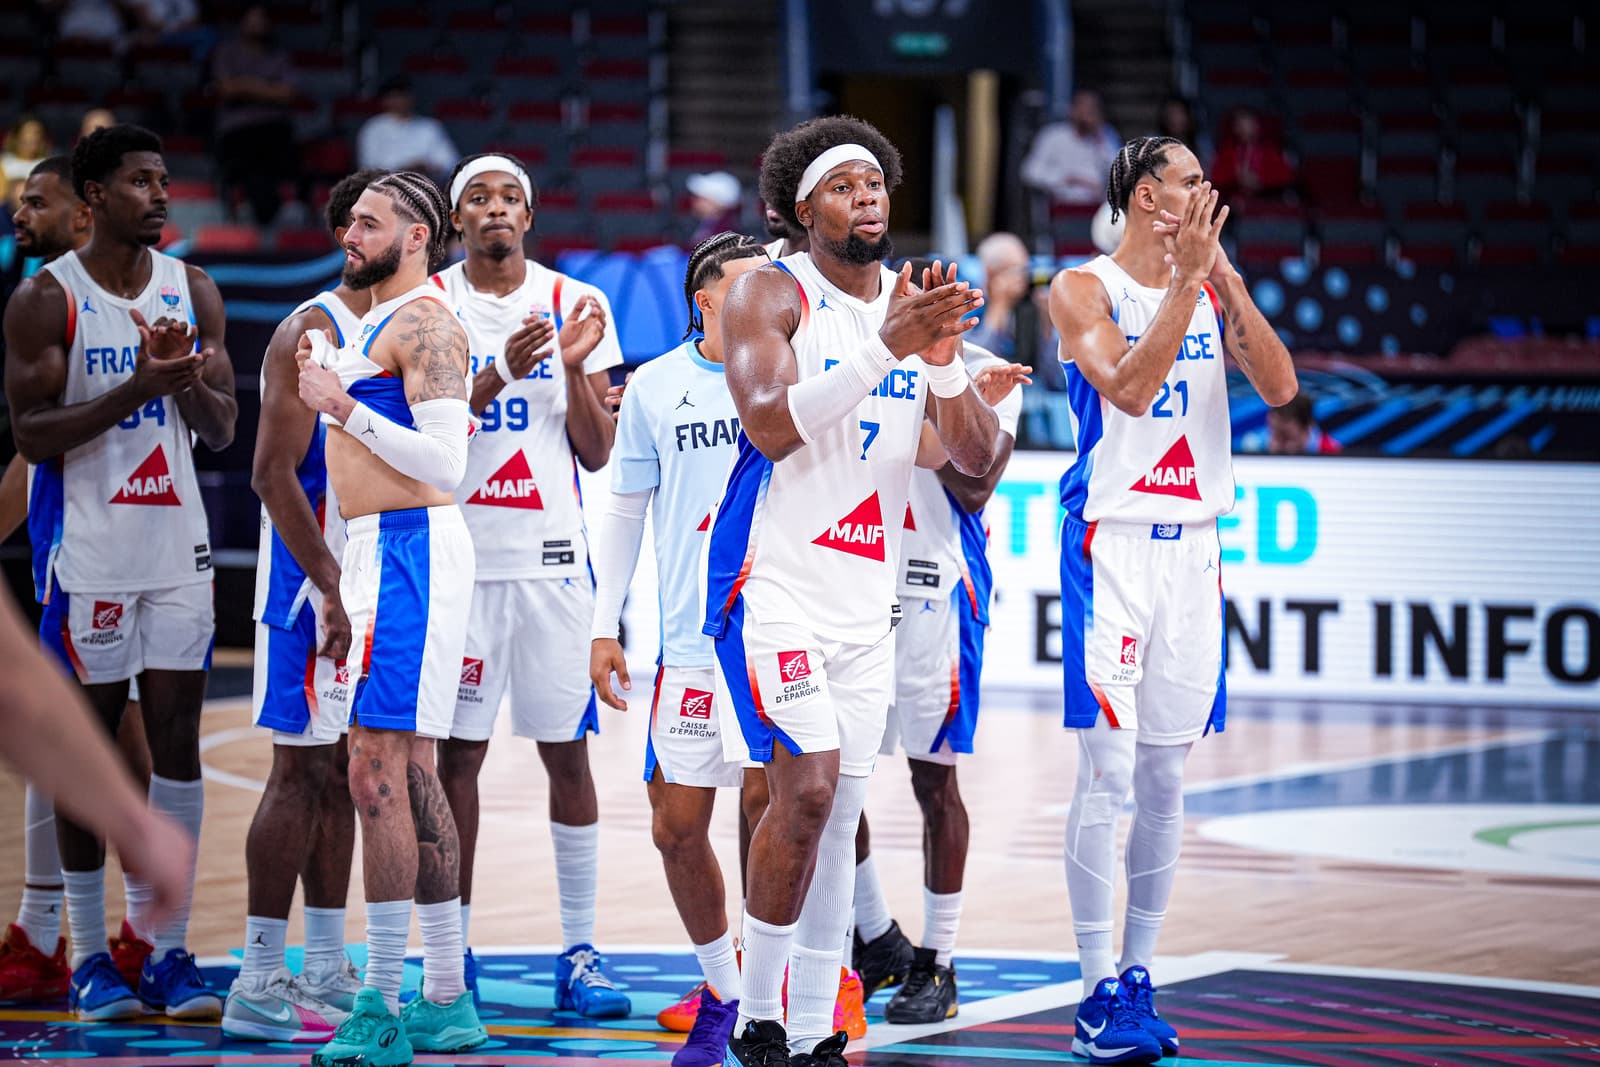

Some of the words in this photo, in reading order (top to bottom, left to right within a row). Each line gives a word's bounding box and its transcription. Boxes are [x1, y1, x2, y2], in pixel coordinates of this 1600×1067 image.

[85, 347, 139, 375] FRA
[1152, 380, 1189, 418] 21
[480, 398, 528, 432] 99
[675, 417, 740, 452] FRA
[859, 420, 880, 461] 7
[121, 474, 172, 498] MAIF
[479, 478, 537, 499] MAIF
[1144, 467, 1197, 487] MAIF
[828, 522, 884, 545] MAIF
[1034, 593, 1339, 675] ENT
[1374, 602, 1600, 687] INFO
[775, 685, 821, 703] D'EPARGNE
[783, 680, 811, 694] CAISSE
[680, 721, 709, 730] CAISSE
